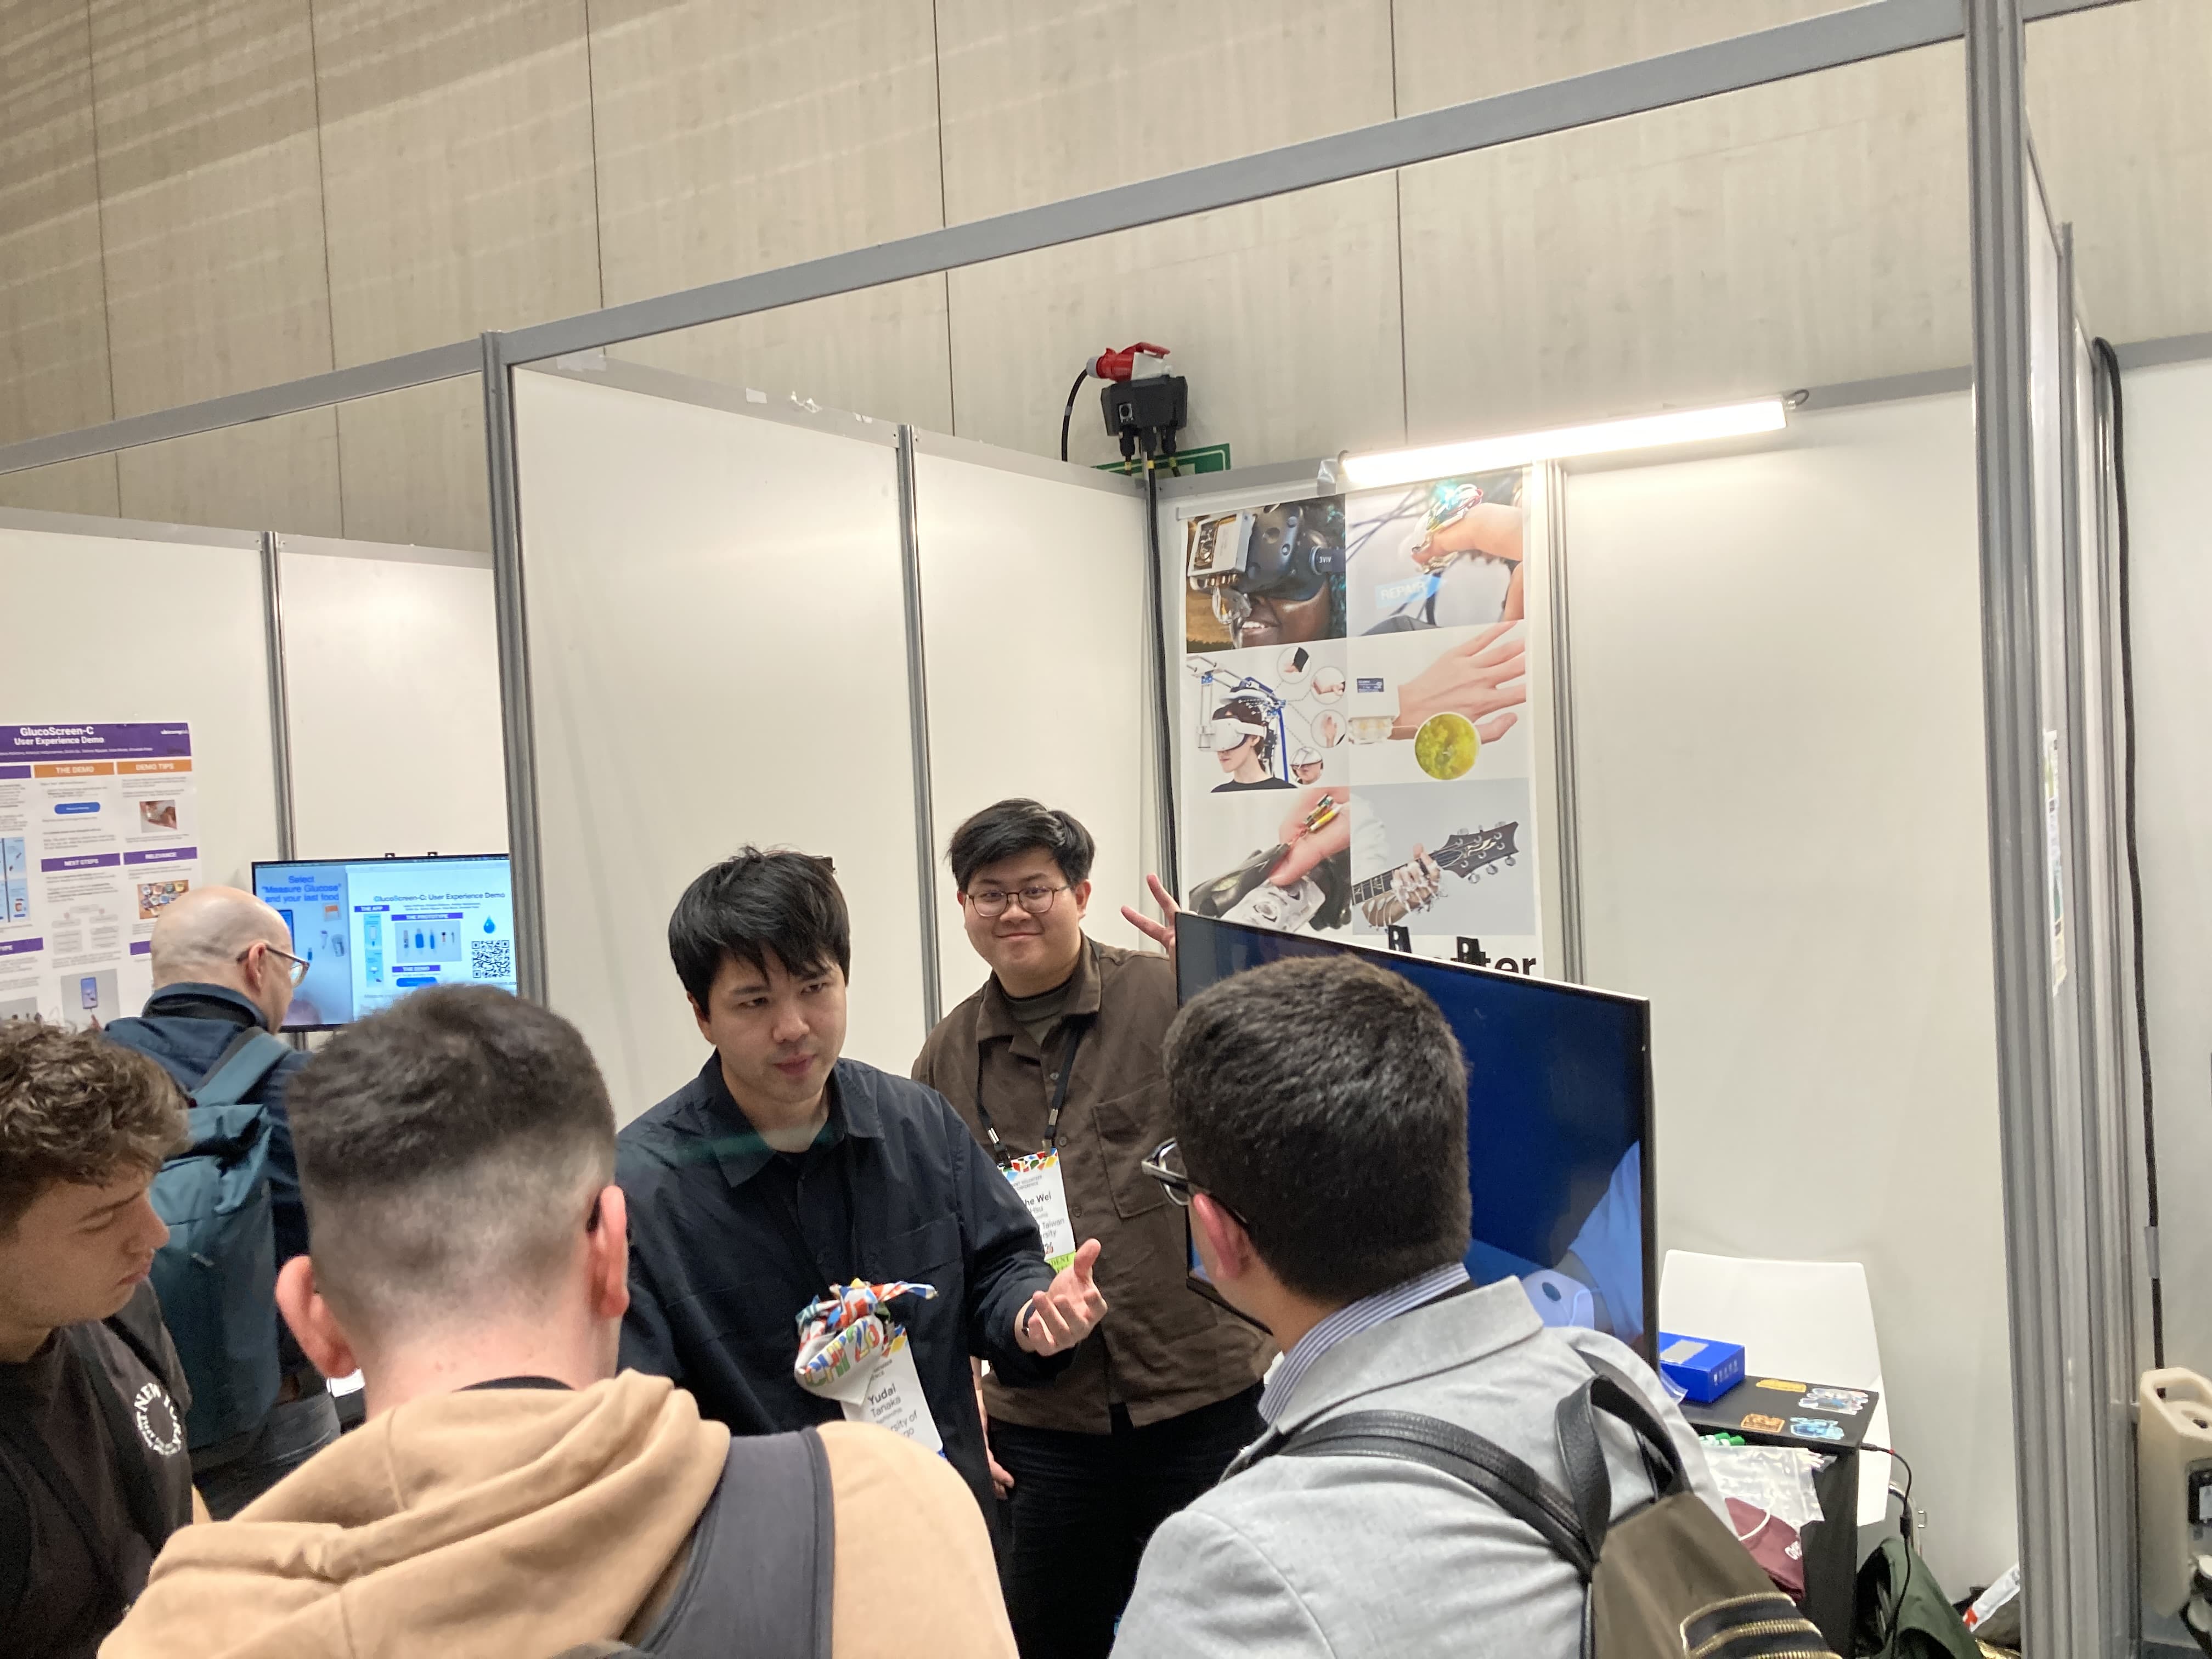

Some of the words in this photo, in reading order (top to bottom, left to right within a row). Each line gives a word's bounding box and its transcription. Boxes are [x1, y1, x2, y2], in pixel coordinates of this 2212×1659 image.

[20, 726, 94, 736] GlucoScreen-C
[35, 736, 80, 746] Experience
[288, 876, 314, 884] Select
[283, 895, 302, 904] your
[321, 893, 339, 901] food
[374, 894, 427, 902] GlucoScreen-C:
[446, 893, 483, 901] Experience
[1024, 1198, 1035, 1207] he
[1036, 1190, 1051, 1203] Wei
[1042, 1218, 1065, 1229] Taiwan
[1043, 1229, 1057, 1238] rsity
[1044, 1242, 1054, 1255] 26
[1050, 1255, 1069, 1266] DENT
[134, 1382, 161, 1413] NEW
[867, 1382, 896, 1405] Yudai
[870, 1396, 901, 1418] Tanaka
[890, 1417, 908, 1432] rsity
[909, 1409, 917, 1422] of
